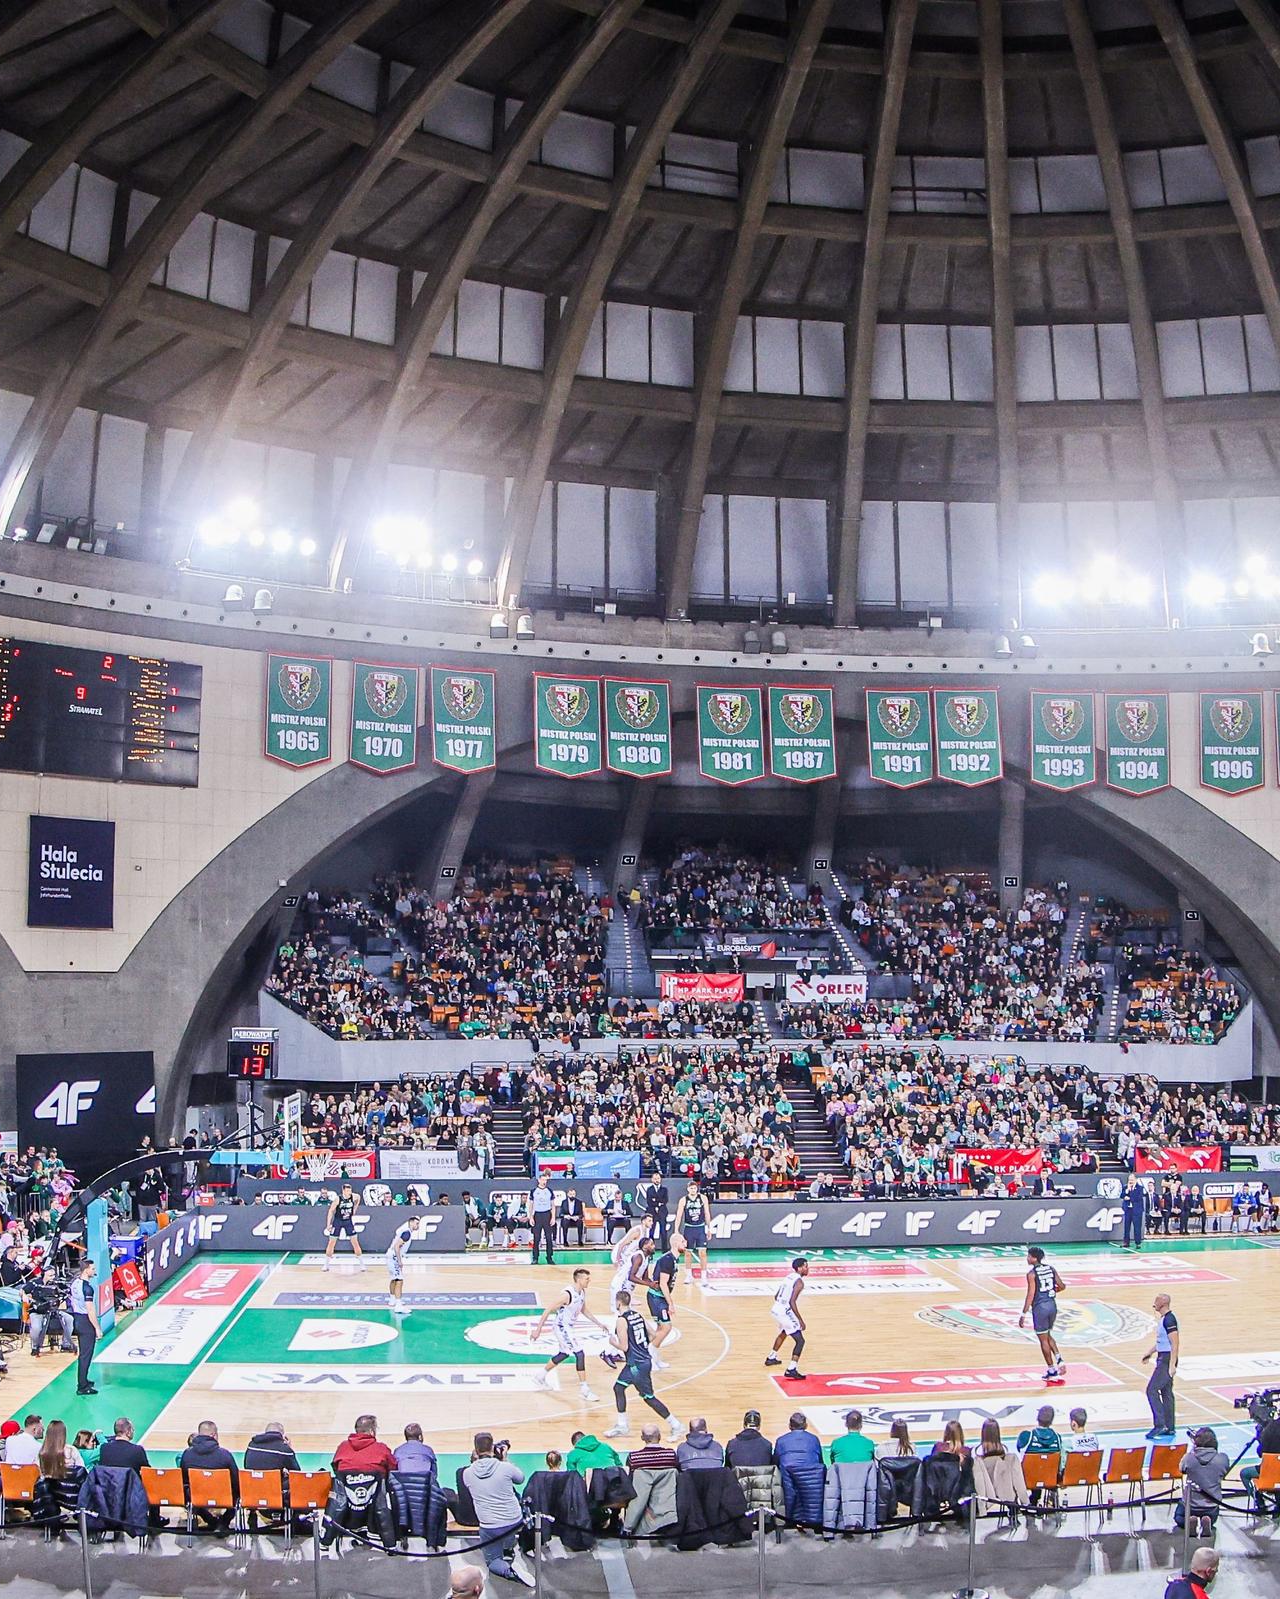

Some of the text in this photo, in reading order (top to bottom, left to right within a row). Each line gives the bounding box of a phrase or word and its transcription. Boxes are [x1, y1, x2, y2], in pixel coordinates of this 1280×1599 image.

[104, 655, 113, 669] 2
[76, 687, 86, 700] 9
[271, 714, 326, 726] MISTRZ POLSKI
[356, 720, 412, 734] MISTRZ POLSKI
[436, 724, 492, 736] MISTRZ POLSKI
[540, 729, 596, 742] MISTRZ POLSKI
[610, 731, 667, 743] MISTRZ POLSKI
[277, 730, 320, 752] 1965
[363, 736, 403, 758] 1970
[703, 738, 760, 748] MISTRZ POLSKI
[774, 737, 830, 748] MISTRZ POLSKI
[872, 742, 928, 751] MISTRZ POLSKI
[940, 740, 996, 750] MISTRZ POLSKI
[446, 739, 483, 758] 1977
[549, 744, 590, 764] 1979
[618, 746, 662, 764] 1980
[1035, 744, 1091, 754] MISTRZ POLSKI
[1110, 747, 1166, 756] MISTRZ POLSKI
[1204, 746, 1259, 756] MISTRZ POLSKI
[711, 752, 752, 770] 1981
[782, 752, 824, 769] 1987
[882, 755, 922, 773] 1991
[947, 754, 990, 772] 1992
[1042, 758, 1085, 777] 1993
[1117, 762, 1158, 780] 1994
[1210, 760, 1253, 779] 1996
[41, 844, 78, 862] Hala
[40, 862, 103, 882] Stulecia
[1005, 878, 1016, 886] C1
[816, 984, 863, 994] ORLEN
[252, 1044, 269, 1056] 46
[244, 1058, 264, 1075] 13
[34, 1080, 100, 1126] 4F
[1009, 1165, 1038, 1173] PLAZA
[252, 1214, 299, 1240] 4F
[710, 1214, 748, 1238] 4F
[772, 1212, 818, 1238] 4F
[841, 1211, 887, 1236] 4F
[957, 1209, 1002, 1234] 4F
[1022, 1208, 1066, 1234] 4F
[1086, 1207, 1125, 1232] 4F
[1040, 1280, 1054, 1292] 13
[272, 1373, 515, 1384] BAZALT
[911, 1371, 1046, 1386] ORLEN
